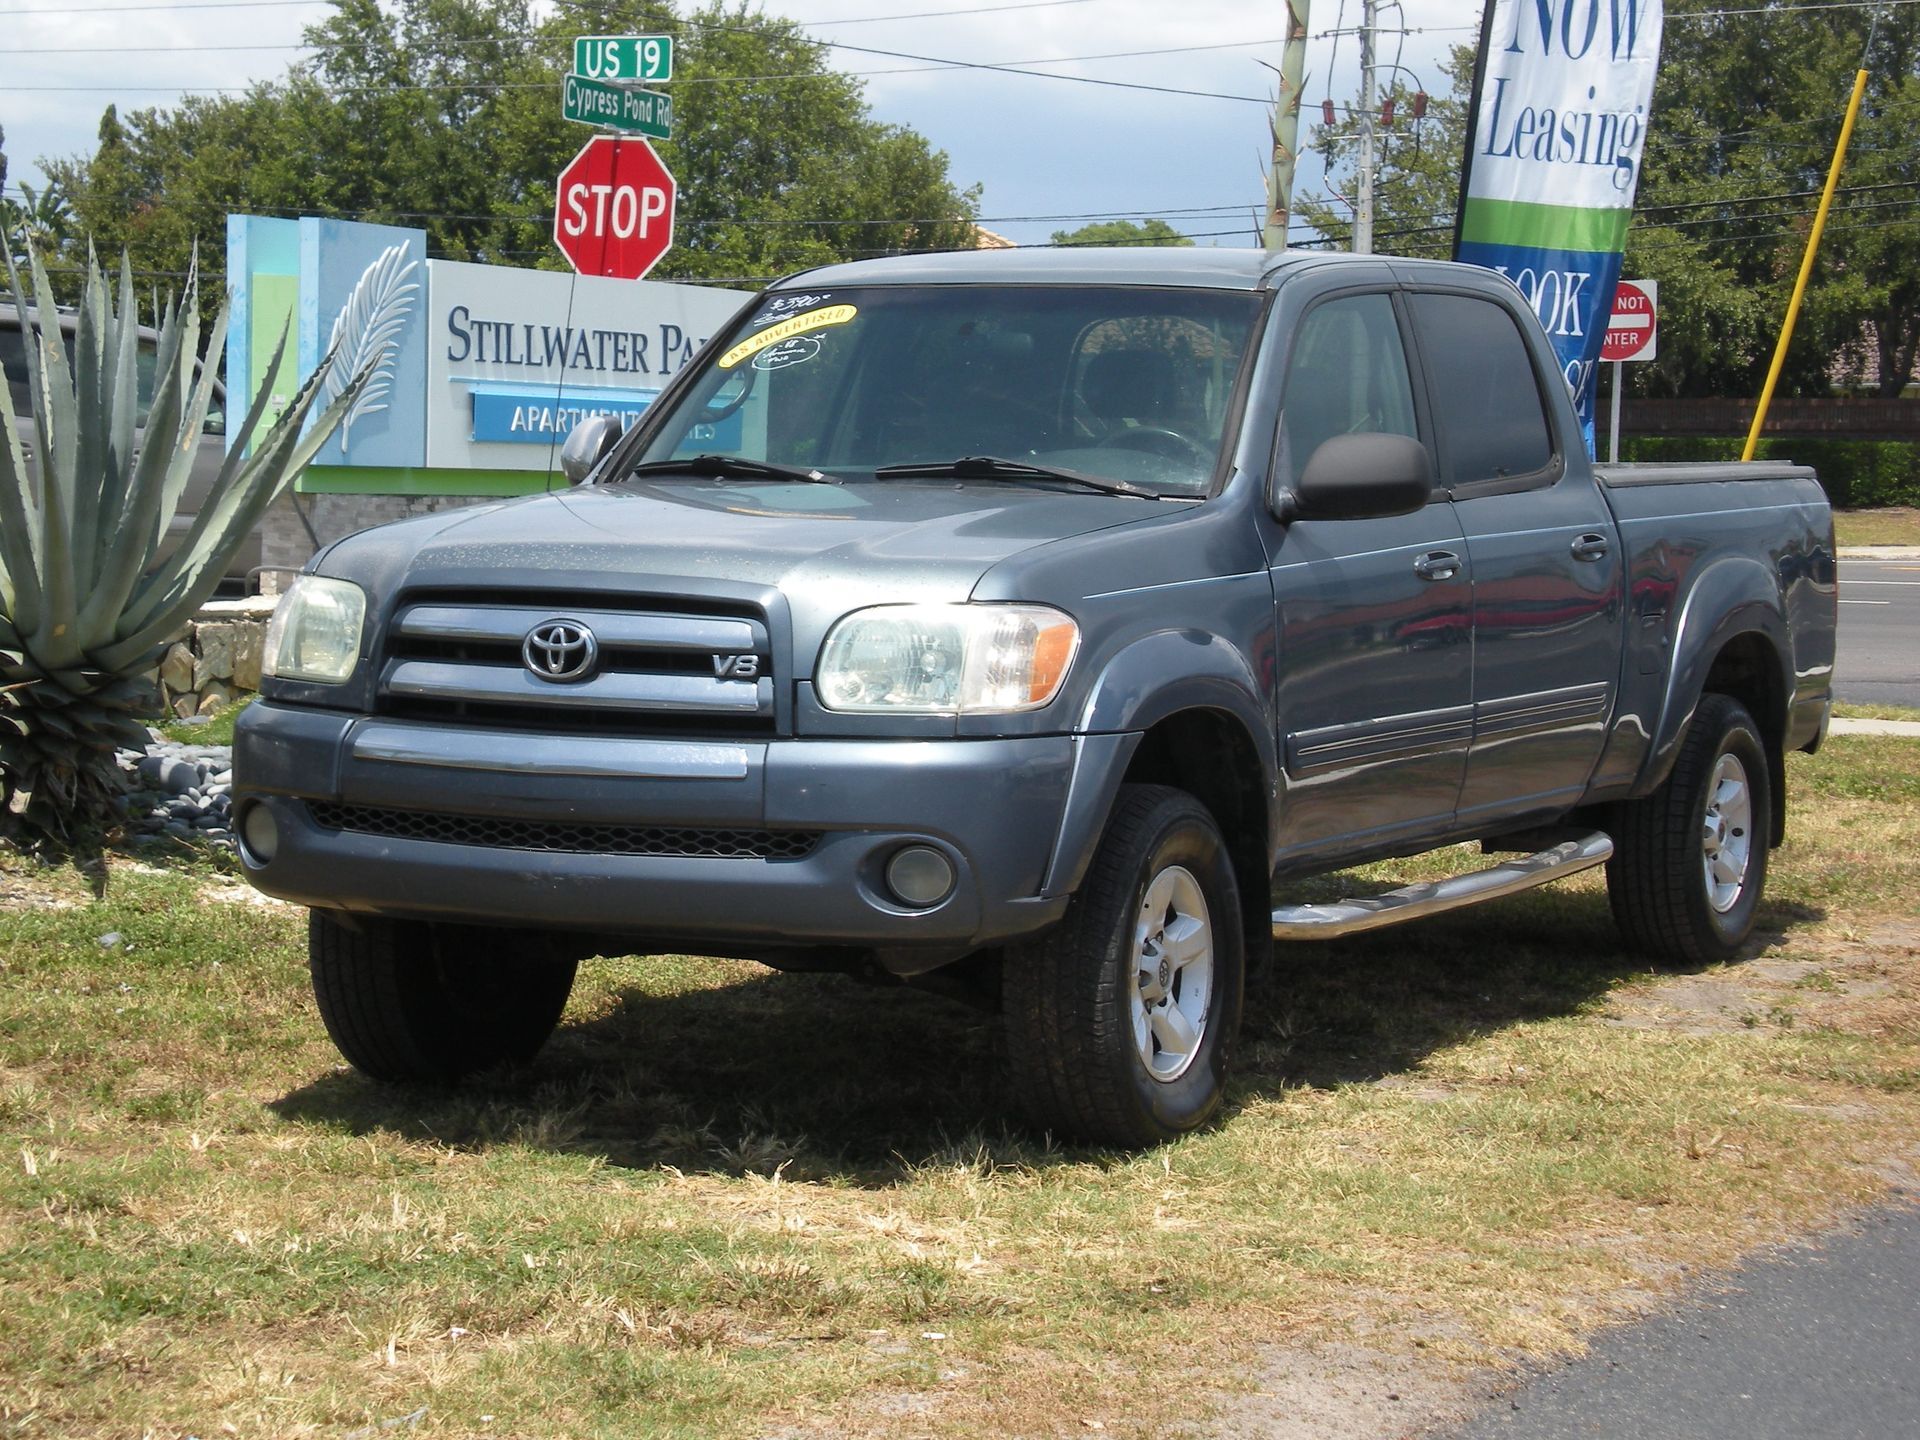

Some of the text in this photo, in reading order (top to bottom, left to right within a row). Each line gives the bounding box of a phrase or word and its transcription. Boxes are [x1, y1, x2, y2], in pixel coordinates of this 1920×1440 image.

[585, 40, 660, 78] US 19
[566, 78, 670, 127] Cypress Pond Rd
[1481, 77, 1642, 190] Leasing
[564, 183, 666, 239] STOP
[1495, 265, 1591, 336] OOK
[1617, 296, 1645, 310] NOT
[447, 305, 650, 373] STILLWATER
[658, 324, 709, 375] PA
[1603, 332, 1638, 345] NTER
[712, 654, 759, 676] V8
